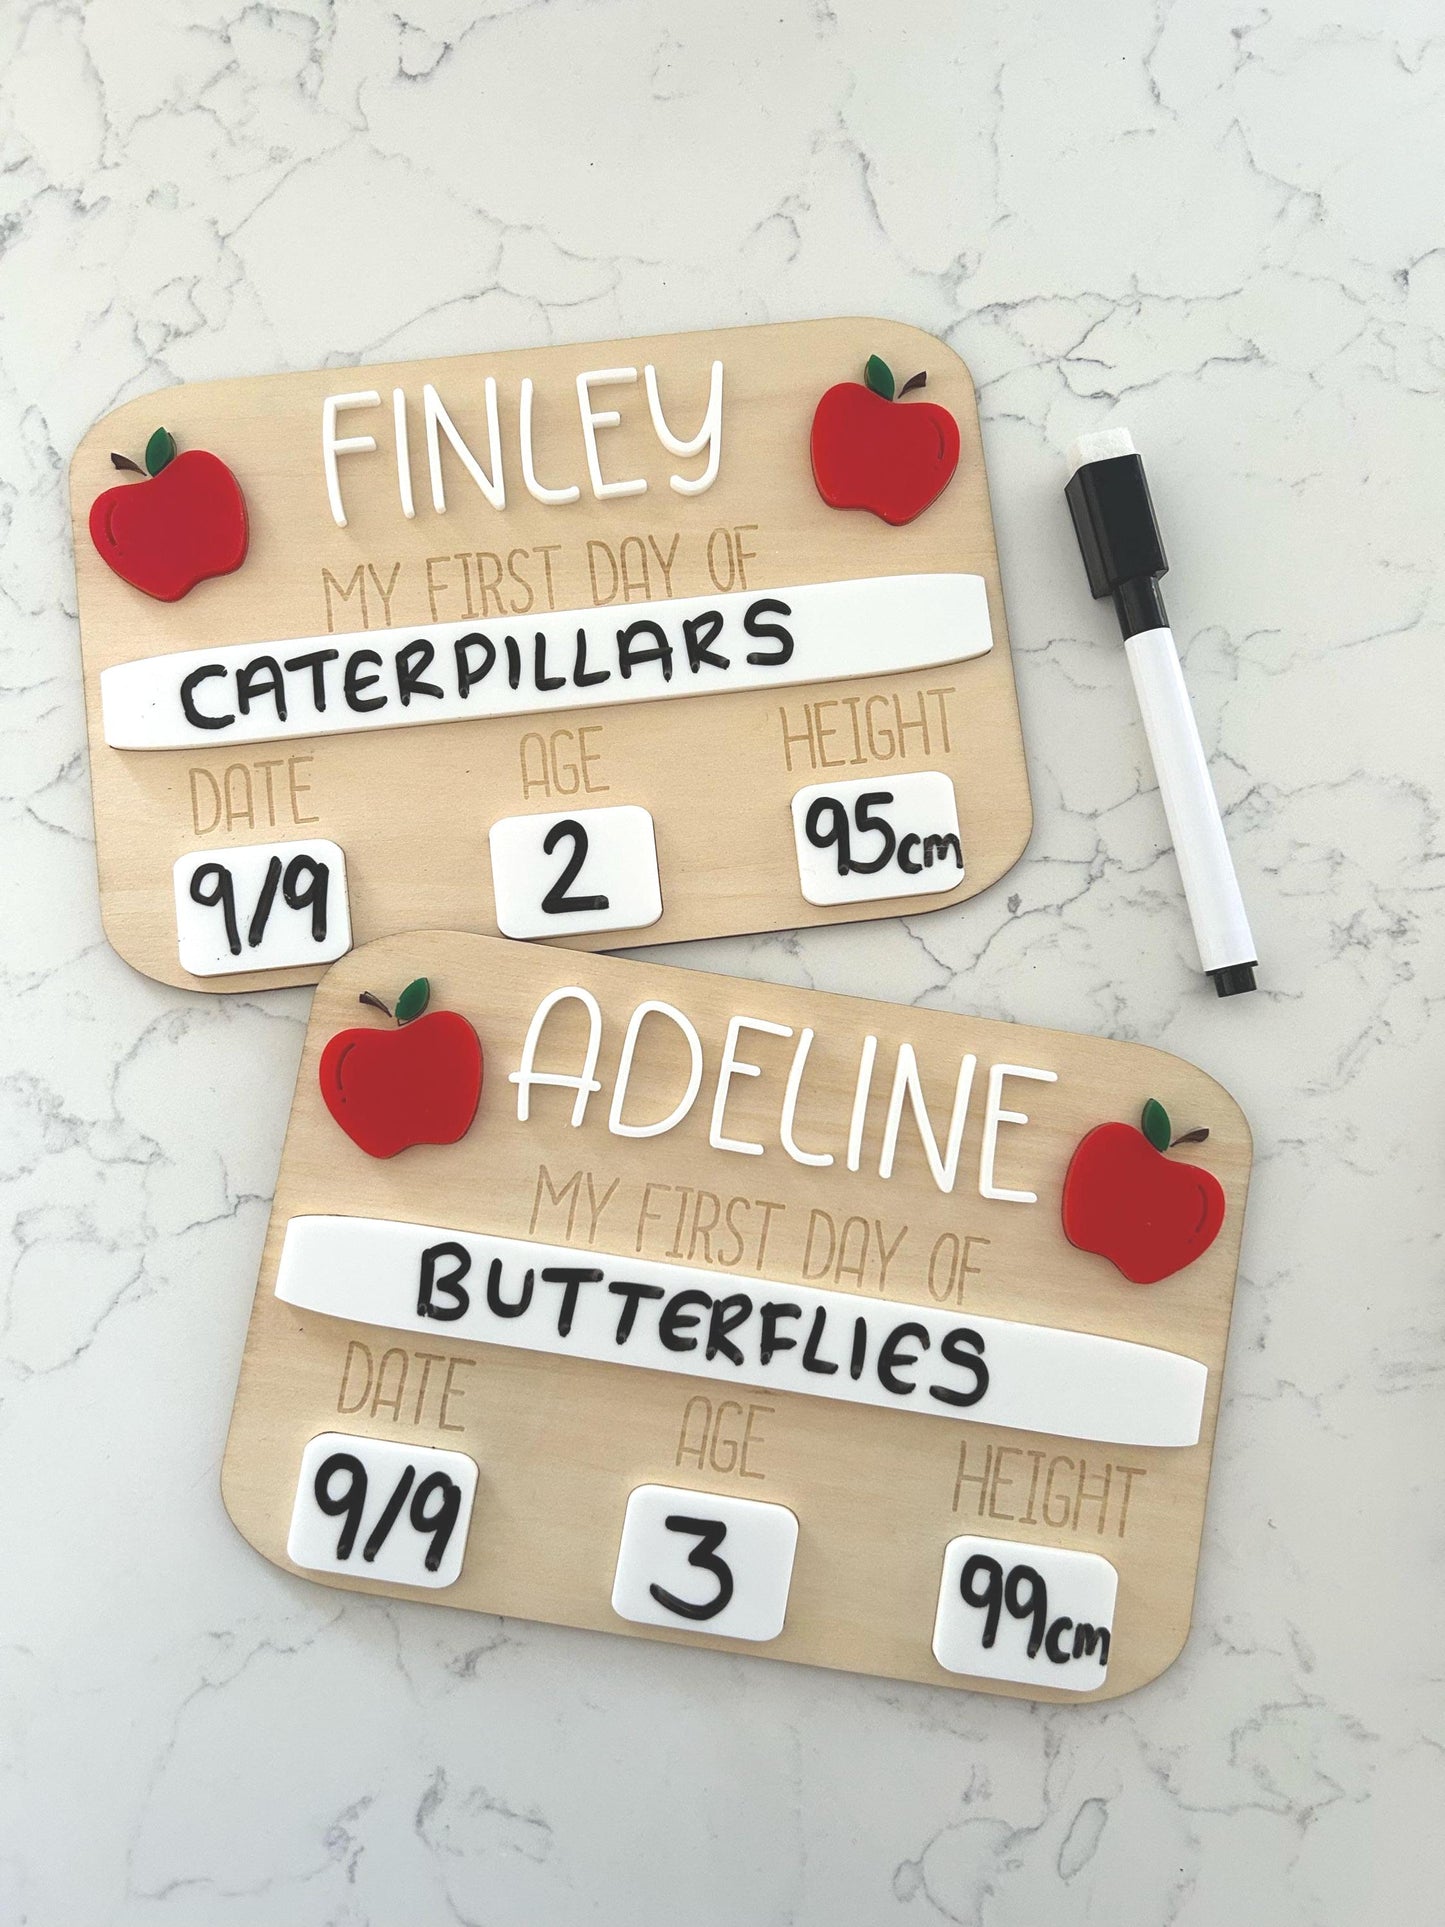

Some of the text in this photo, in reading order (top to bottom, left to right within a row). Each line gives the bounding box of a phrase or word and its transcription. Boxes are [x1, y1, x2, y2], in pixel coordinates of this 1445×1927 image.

[322, 360, 724, 528] FINLEY
[322, 524, 760, 632] MY FIRST DAY OF
[179, 598, 796, 731] CATERPILLARS
[519, 725, 611, 800] AGE
[779, 686, 957, 772] HEIGHT
[189, 755, 320, 836] DATE
[189, 852, 331, 956] 9/9
[540, 818, 610, 915] 2
[508, 985, 1059, 1204] ADELINE
[529, 1163, 992, 1305] MY FIRST DAY OF
[416, 1241, 990, 1408] BUTTERFLIES
[336, 1340, 478, 1433] DATE
[675, 1394, 776, 1480] AGE
[313, 1451, 462, 1572] 9/9
[951, 1440, 1147, 1539] HEIGHT
[649, 1514, 735, 1621] 3
